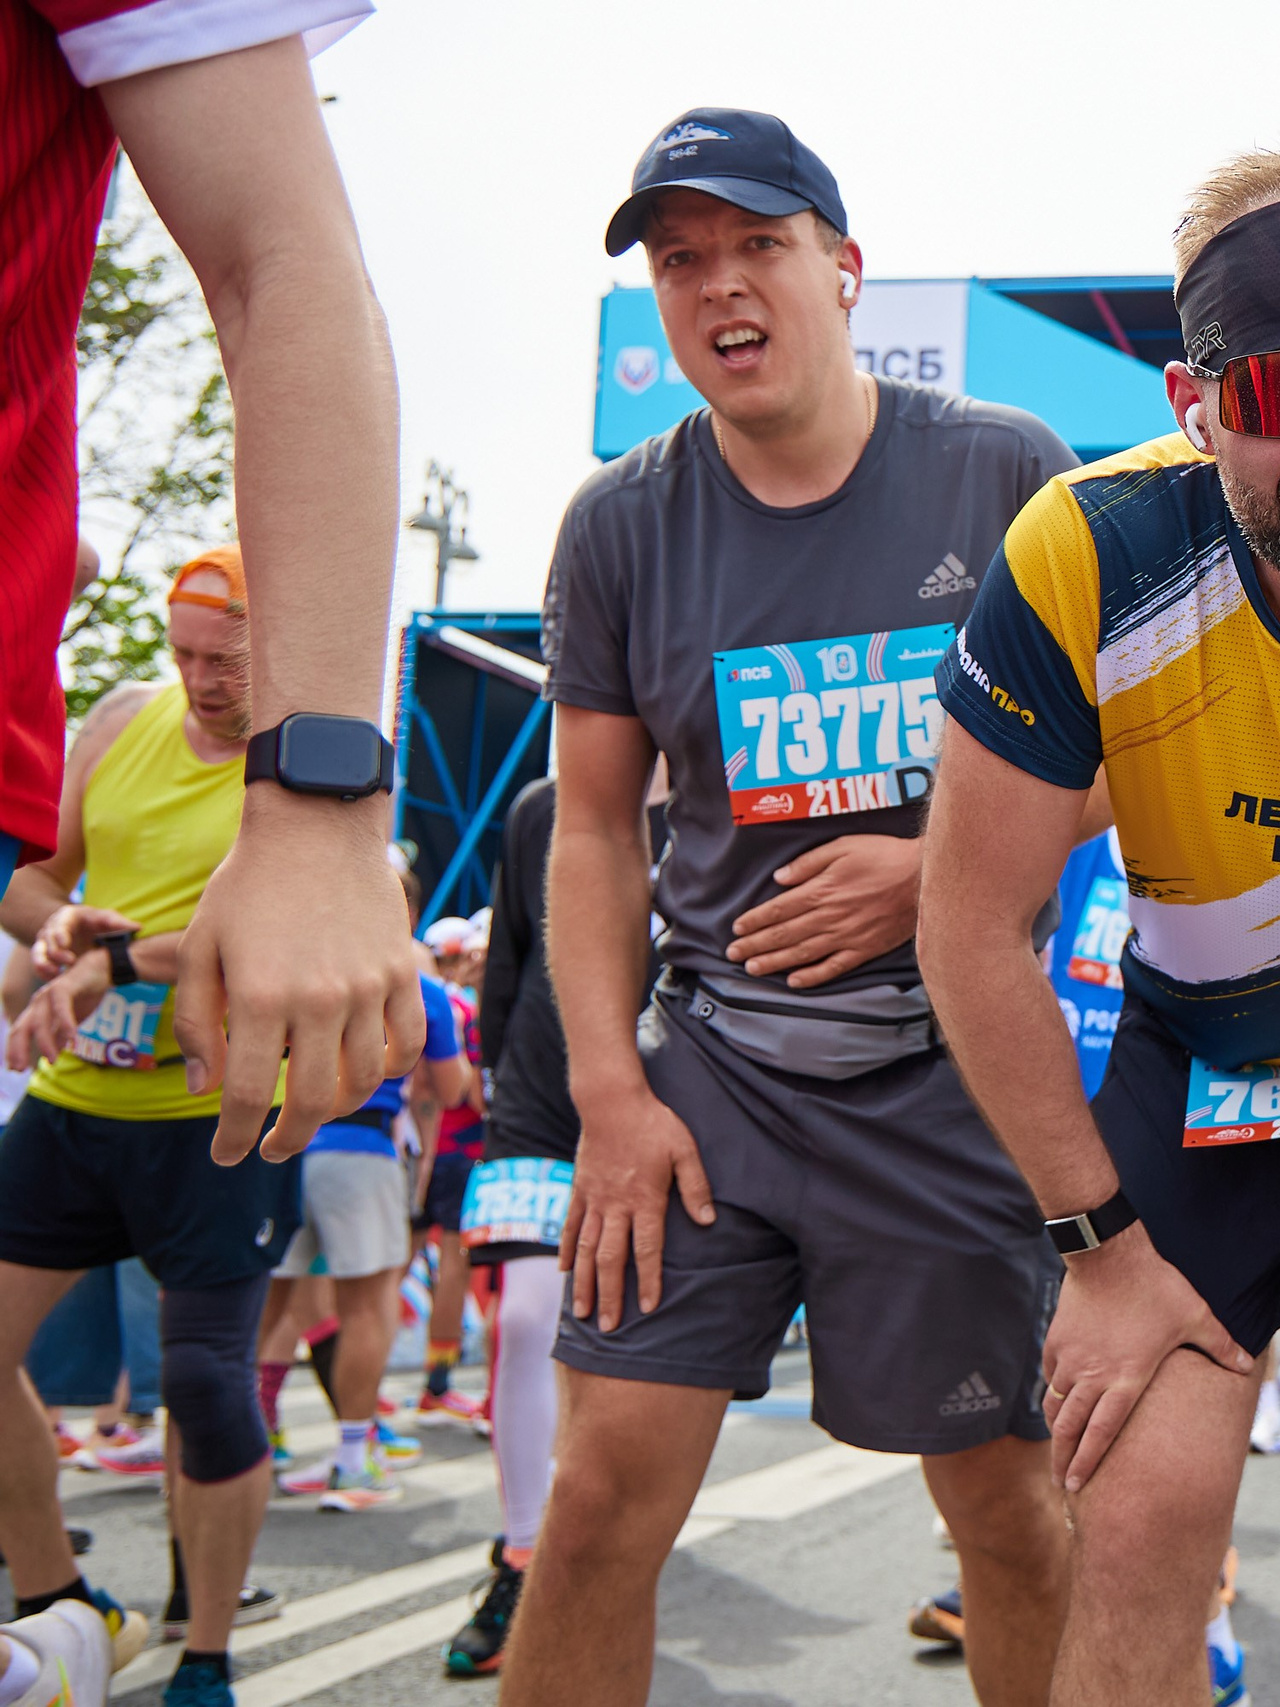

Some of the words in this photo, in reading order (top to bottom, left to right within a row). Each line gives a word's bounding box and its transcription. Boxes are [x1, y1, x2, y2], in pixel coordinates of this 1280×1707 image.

[740, 665, 772, 682] ПСБ
[816, 643, 859, 683] 10
[991, 685, 1036, 727] ПРО
[739, 676, 945, 781] 73775
